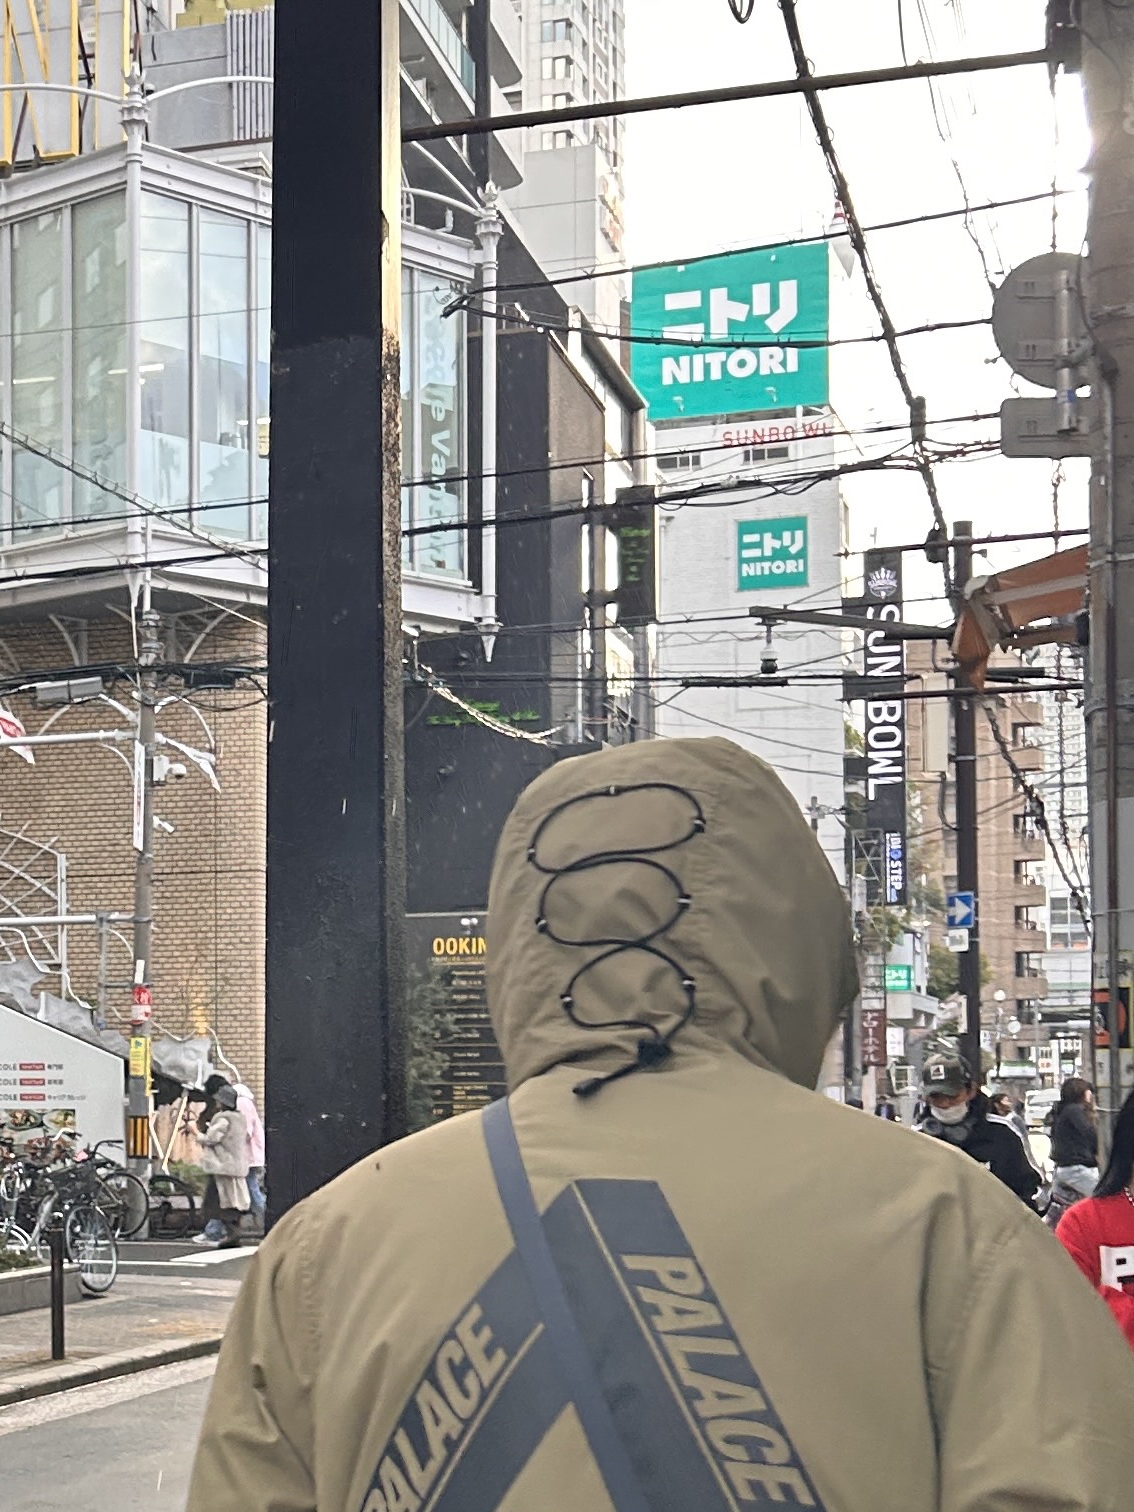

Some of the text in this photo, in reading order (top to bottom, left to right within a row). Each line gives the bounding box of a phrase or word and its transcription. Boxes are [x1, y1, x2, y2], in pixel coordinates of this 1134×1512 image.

[662, 279, 798, 342] ニトリ
[661, 346, 799, 386] NITORI
[741, 529, 804, 558] ニトリ
[741, 559, 804, 577] NITORI
[867, 700, 903, 801] BOWL
[618, 1253, 816, 1507] PALACE
